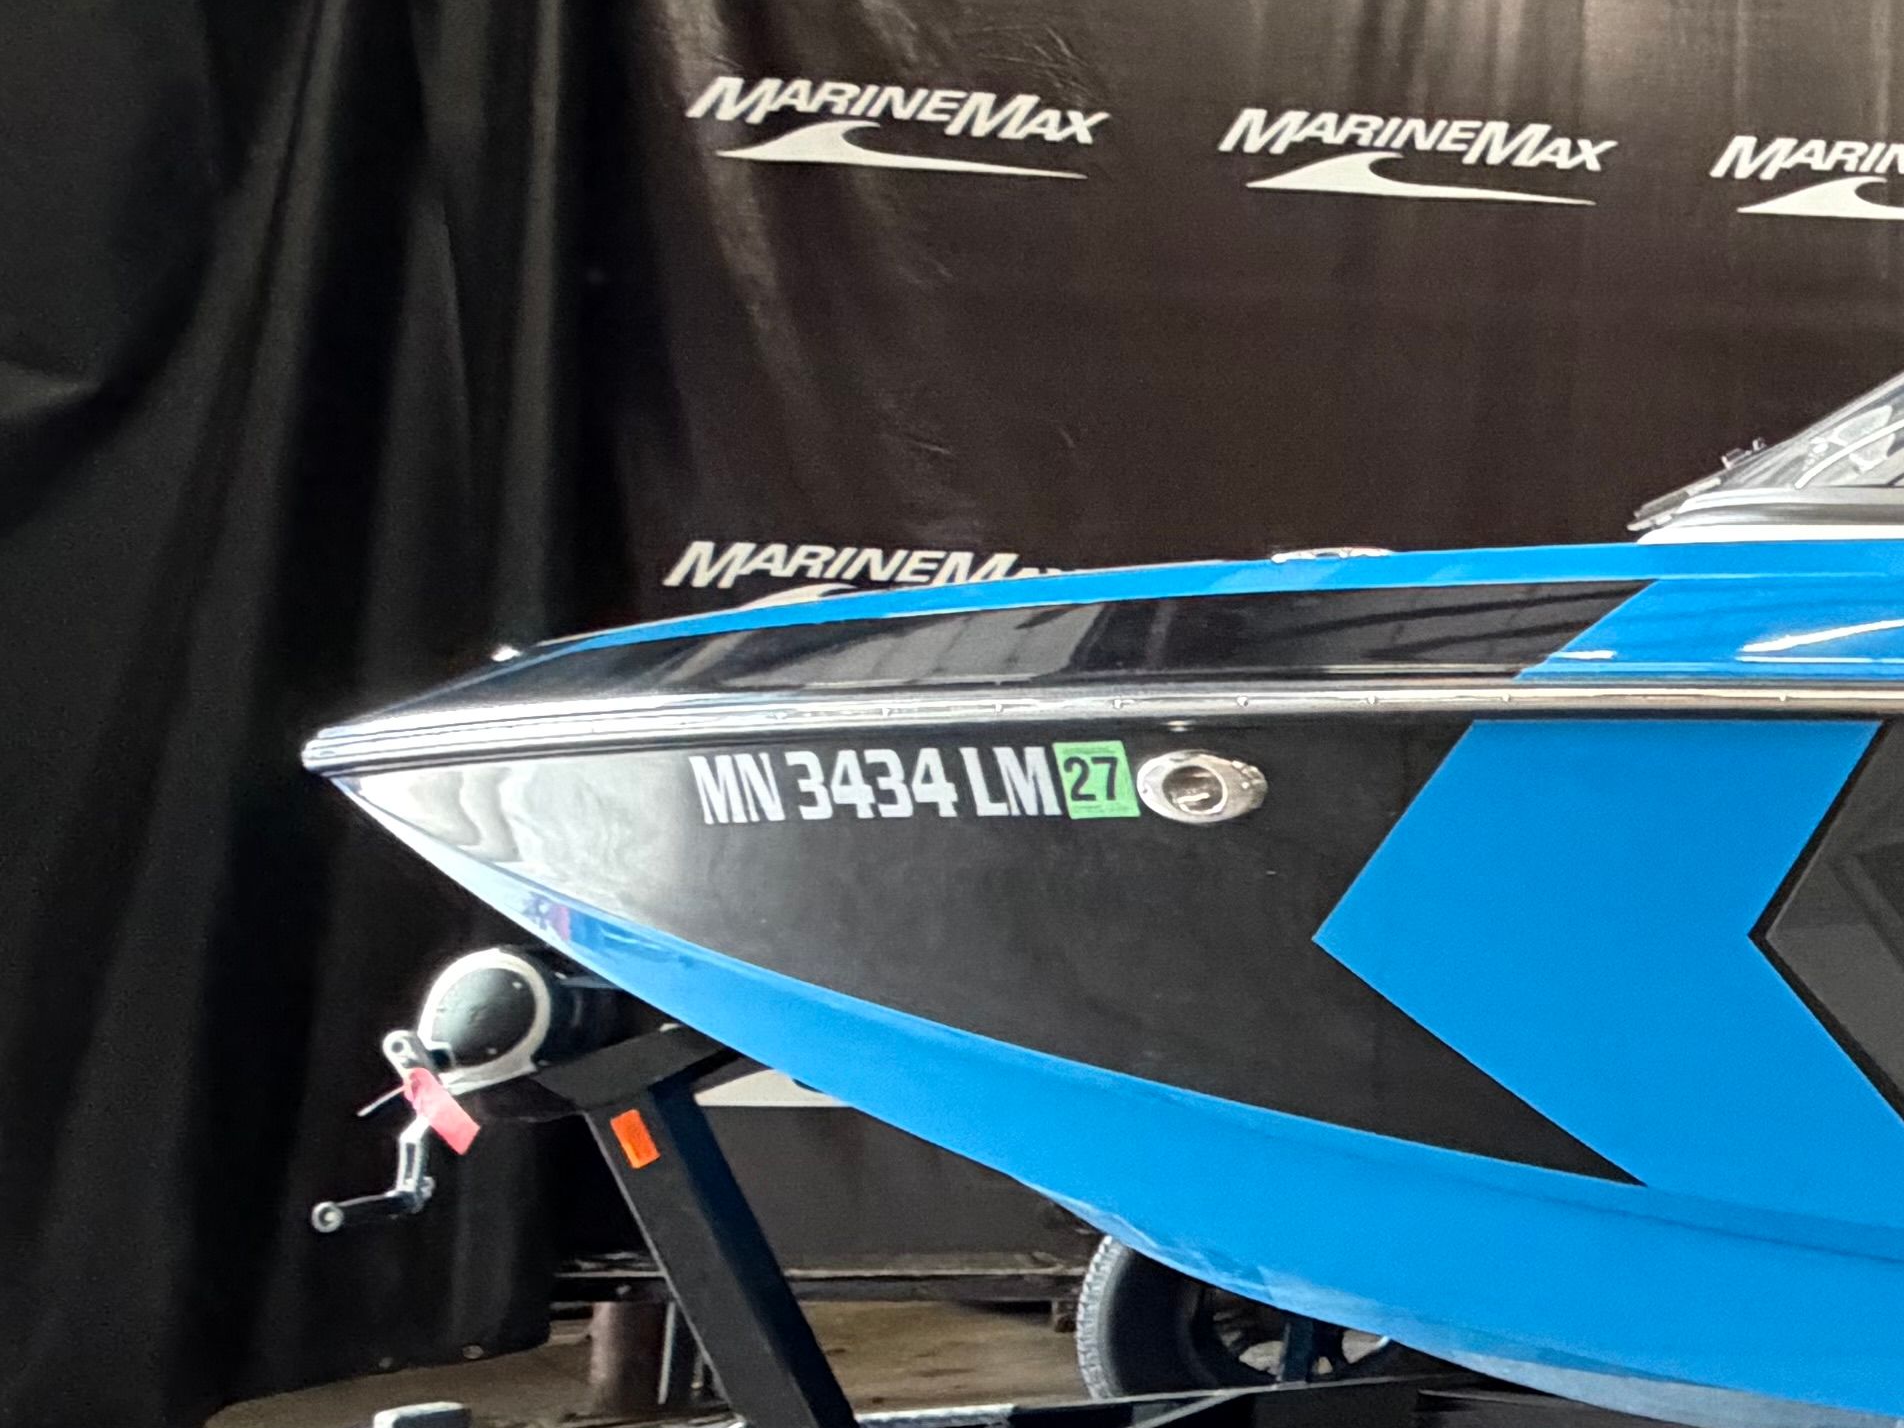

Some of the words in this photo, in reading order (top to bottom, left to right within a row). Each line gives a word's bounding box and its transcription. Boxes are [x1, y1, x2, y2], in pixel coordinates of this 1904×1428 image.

[690, 755, 786, 825] MN
[796, 746, 958, 820] 3434
[959, 744, 1062, 817] LM
[1063, 755, 1119, 802] 27
